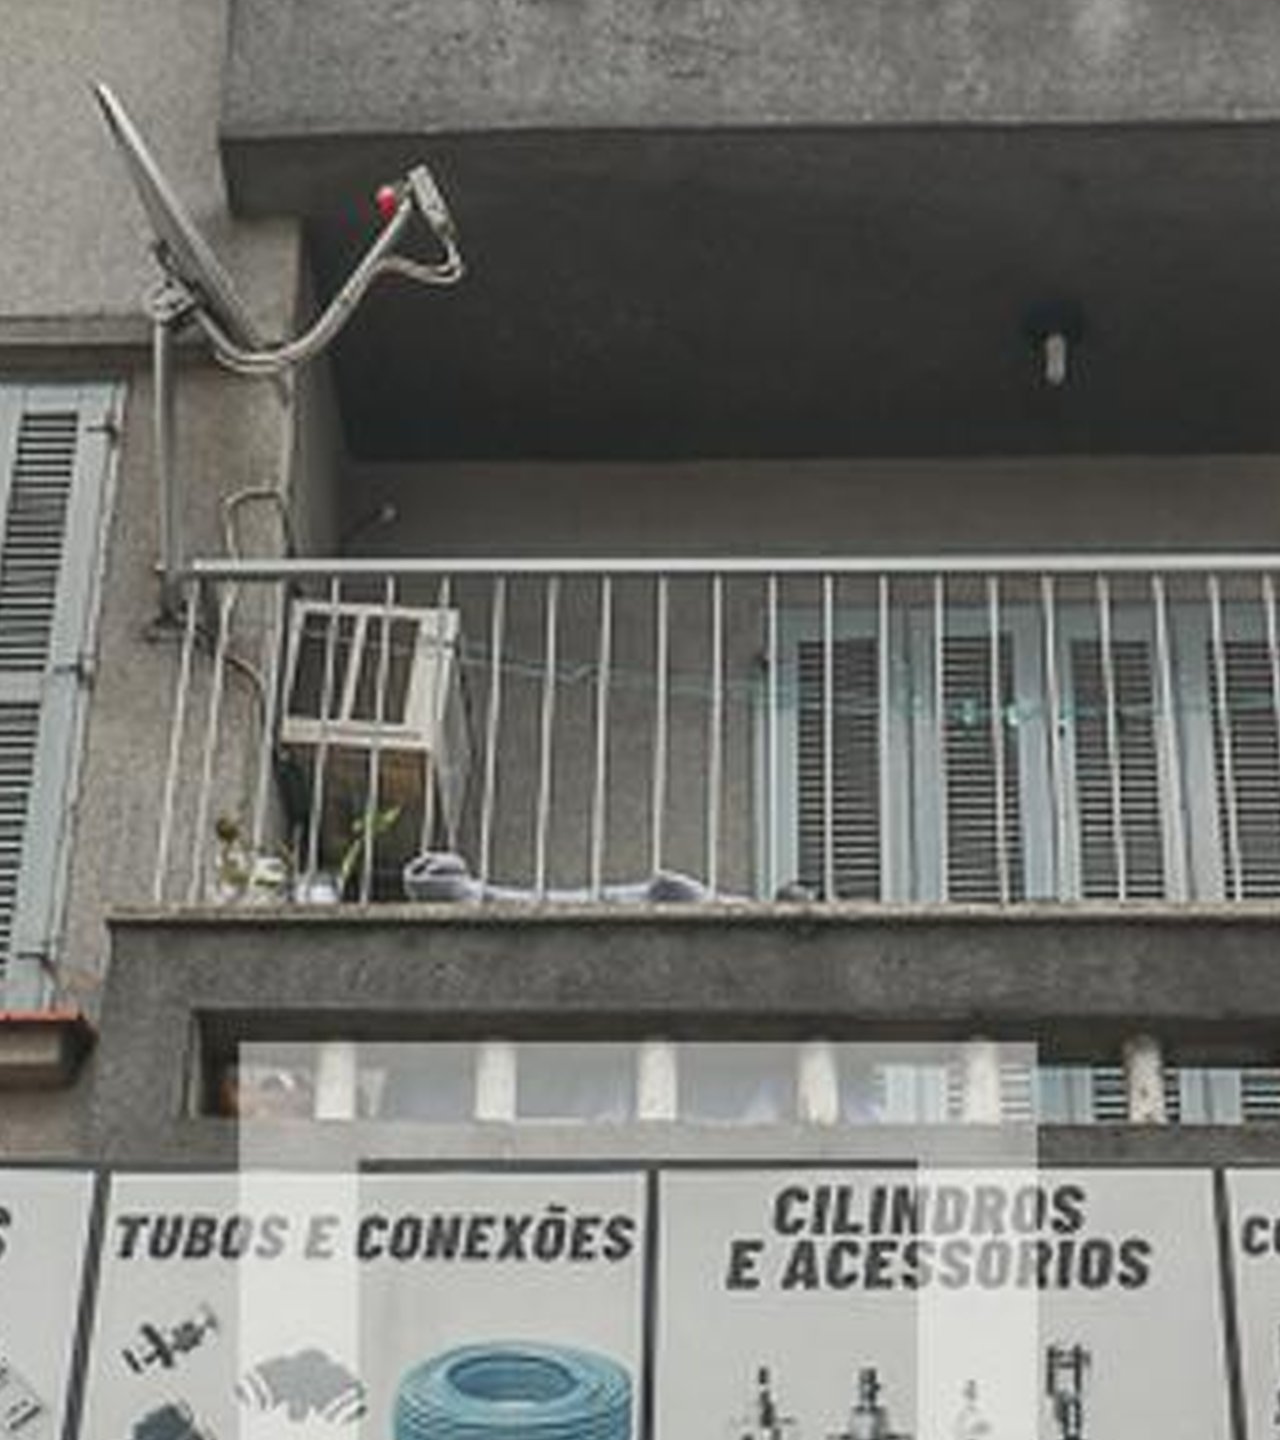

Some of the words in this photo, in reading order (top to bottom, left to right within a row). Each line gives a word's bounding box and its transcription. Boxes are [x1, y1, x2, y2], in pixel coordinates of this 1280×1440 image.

[116, 1213, 287, 1261] TUBOS
[304, 1213, 339, 1261] E
[354, 1204, 637, 1262] CONEXÕES
[773, 1185, 1087, 1235] CILINDROS
[725, 1239, 764, 1289] E
